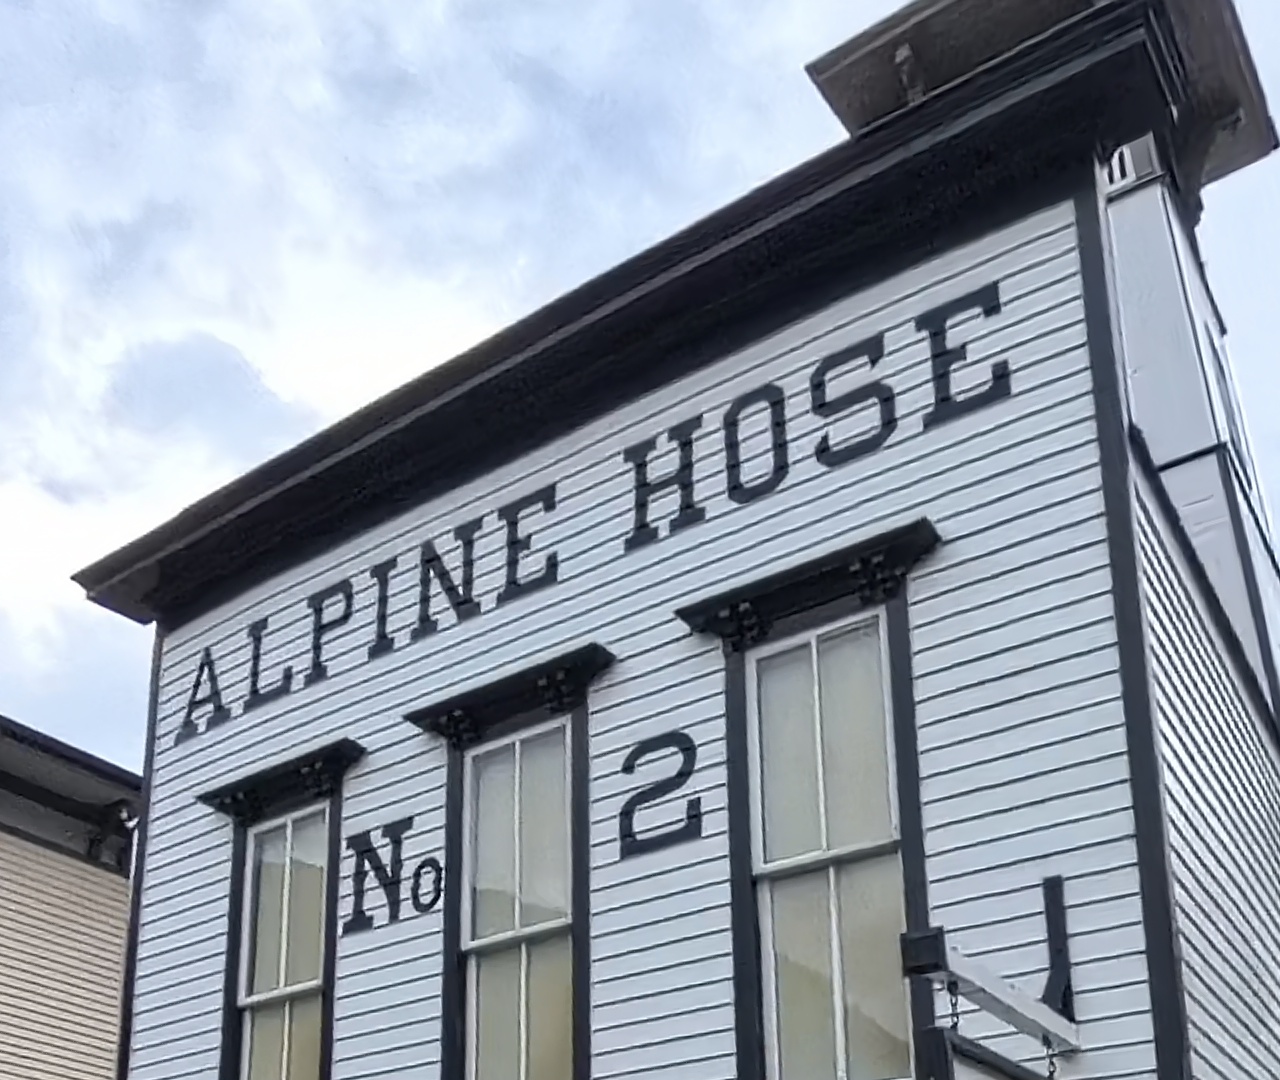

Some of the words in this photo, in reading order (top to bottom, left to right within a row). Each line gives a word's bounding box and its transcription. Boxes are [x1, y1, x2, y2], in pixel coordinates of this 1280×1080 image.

[174, 483, 559, 743] ALPINE
[624, 281, 1011, 550] HOSE
[342, 817, 443, 937] No
[620, 730, 702, 860] 2
